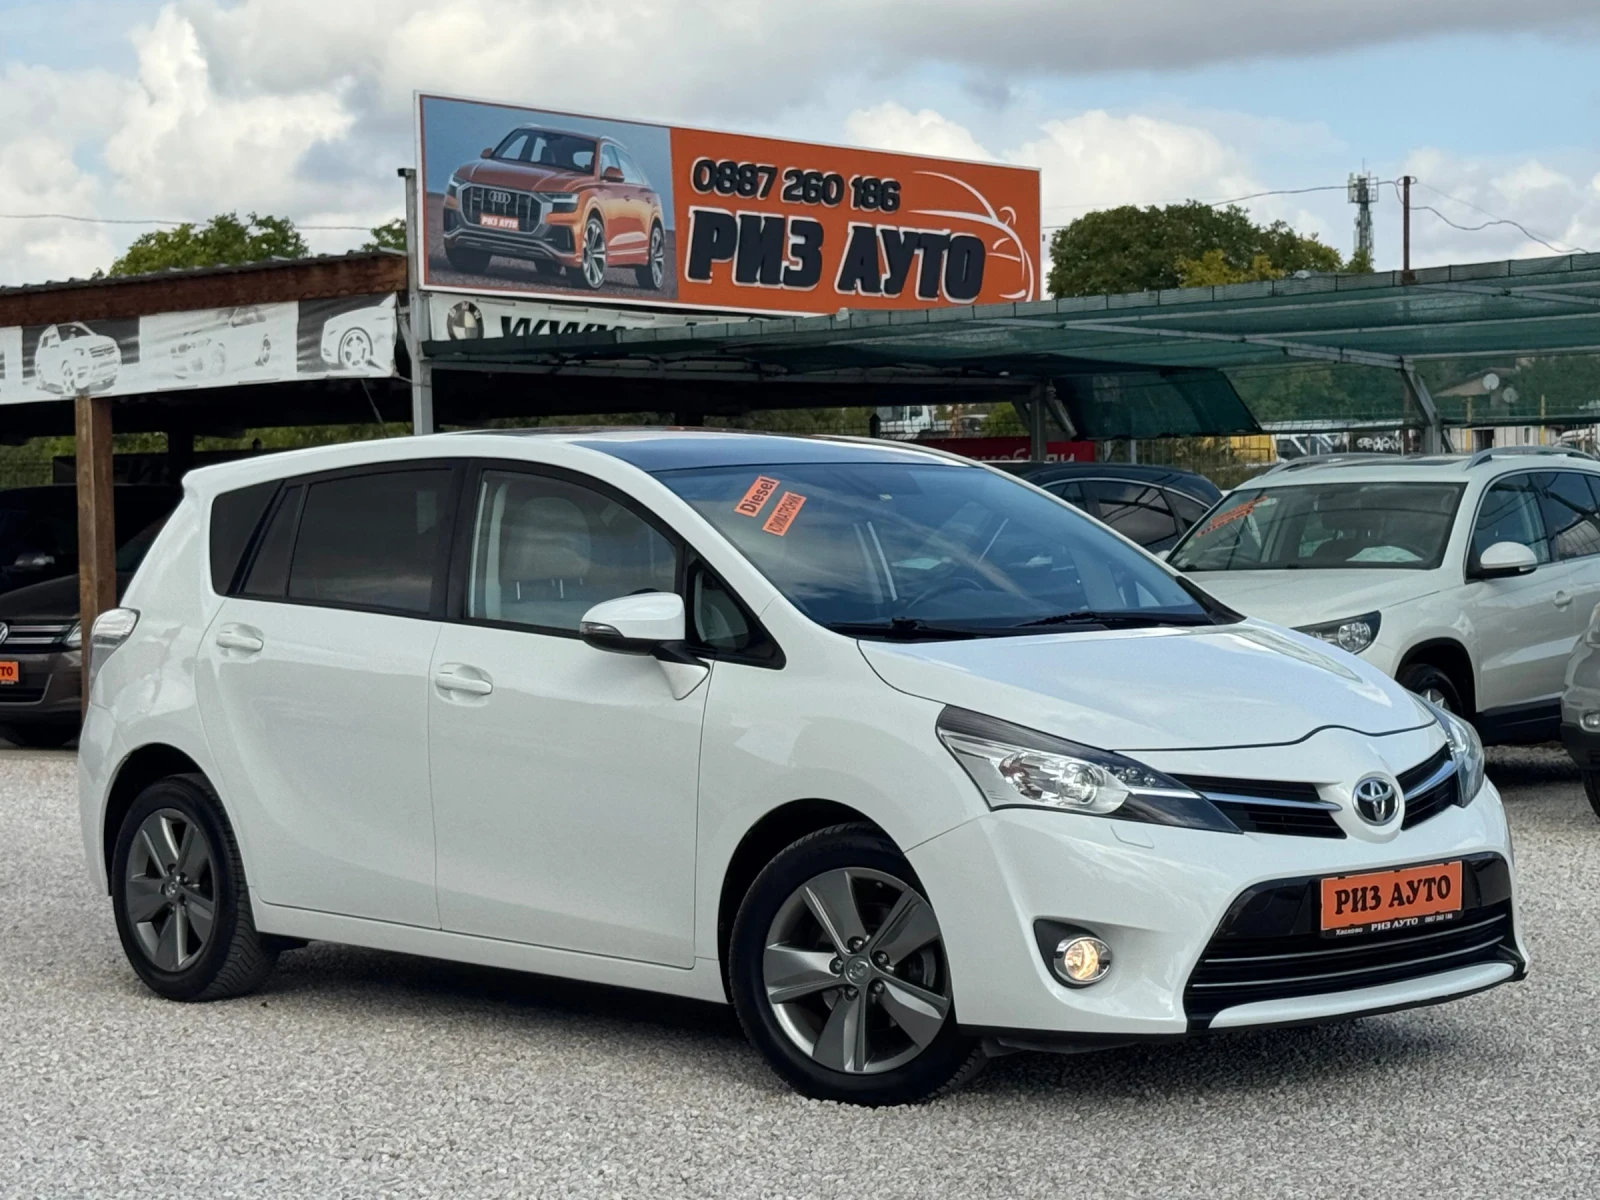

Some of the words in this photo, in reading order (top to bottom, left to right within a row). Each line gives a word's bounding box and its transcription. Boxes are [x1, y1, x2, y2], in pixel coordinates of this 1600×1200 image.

[691, 157, 777, 200] 0887
[780, 166, 845, 208] 260
[848, 175, 902, 213] 186
[685, 206, 825, 292] РИЗ
[834, 221, 986, 304] АУТО
[739, 478, 777, 513] Diesel
[1334, 885, 1382, 915] РИЗ
[1388, 875, 1452, 908] АУТО
[1371, 921, 1391, 932] РИЗ
[1392, 917, 1419, 929] АУТО
